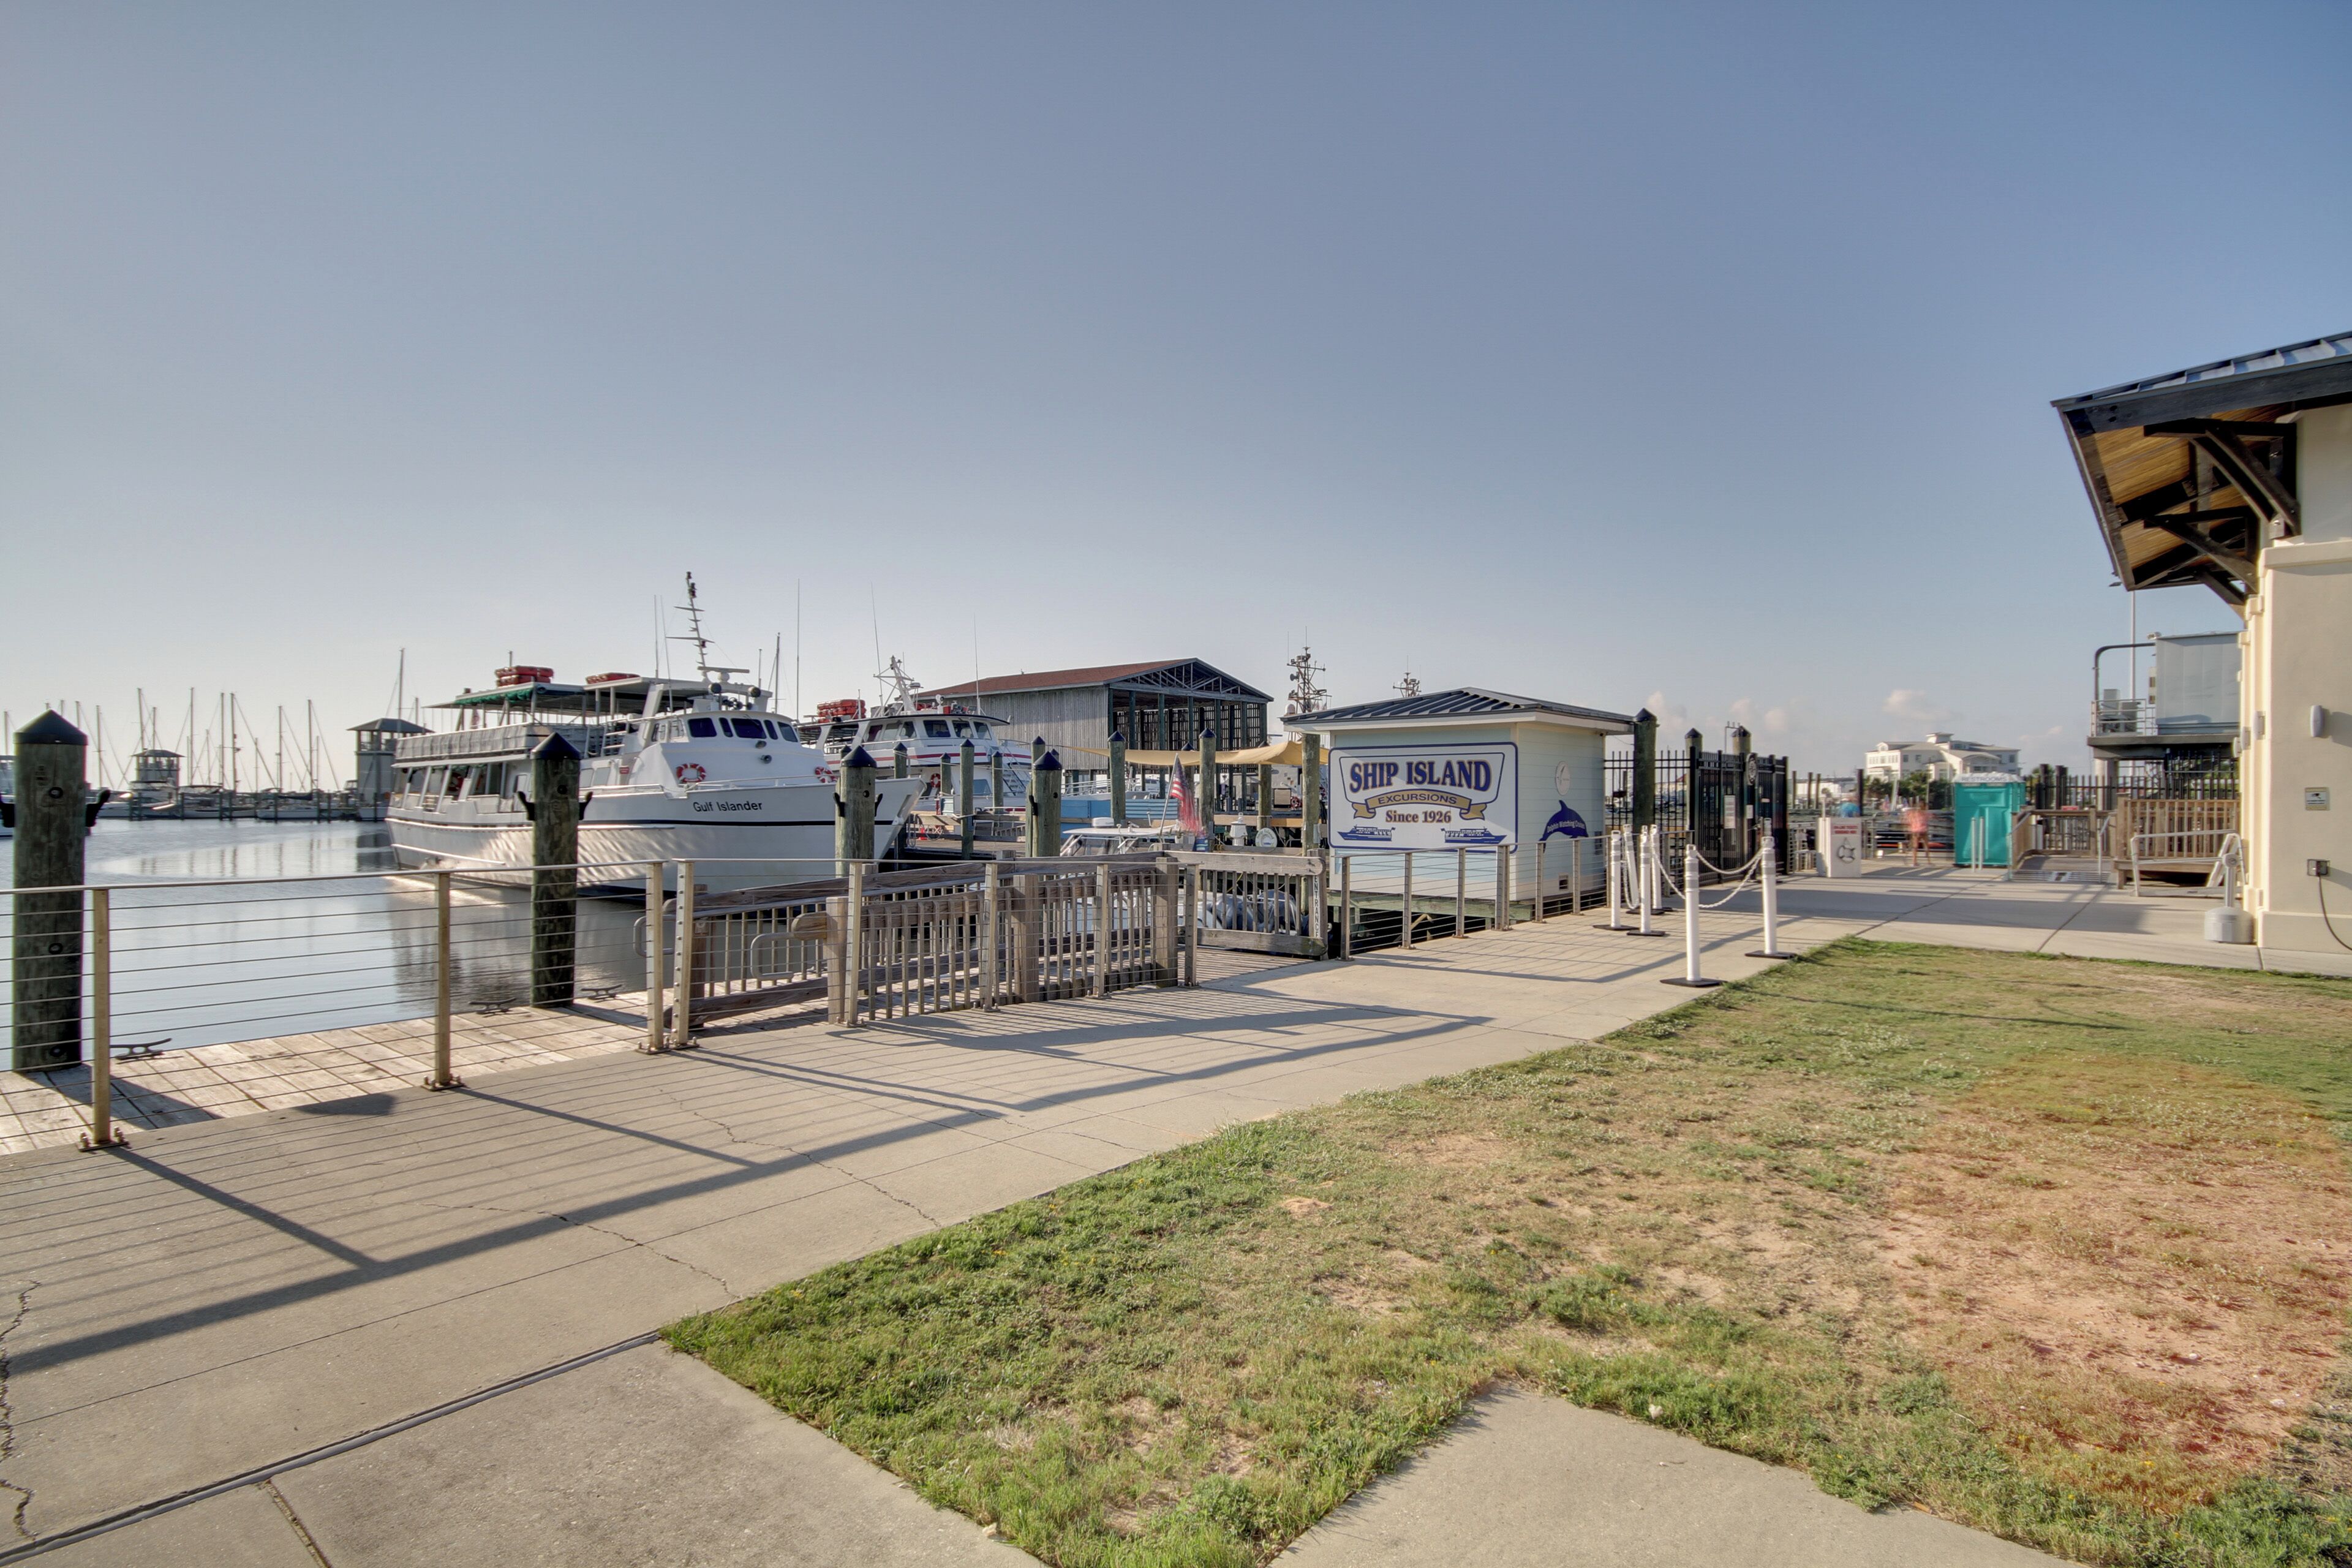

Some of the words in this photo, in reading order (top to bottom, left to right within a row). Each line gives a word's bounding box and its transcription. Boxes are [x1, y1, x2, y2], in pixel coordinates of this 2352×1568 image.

[1349, 761, 1400, 793] SHIP
[1406, 760, 1491, 792] ISLAND
[1378, 793, 1458, 805] EXCURSIONS
[693, 801, 714, 812] Gulf
[716, 801, 763, 812] Islander
[1385, 810, 1419, 823] Since
[1422, 810, 1452, 824] 1926
